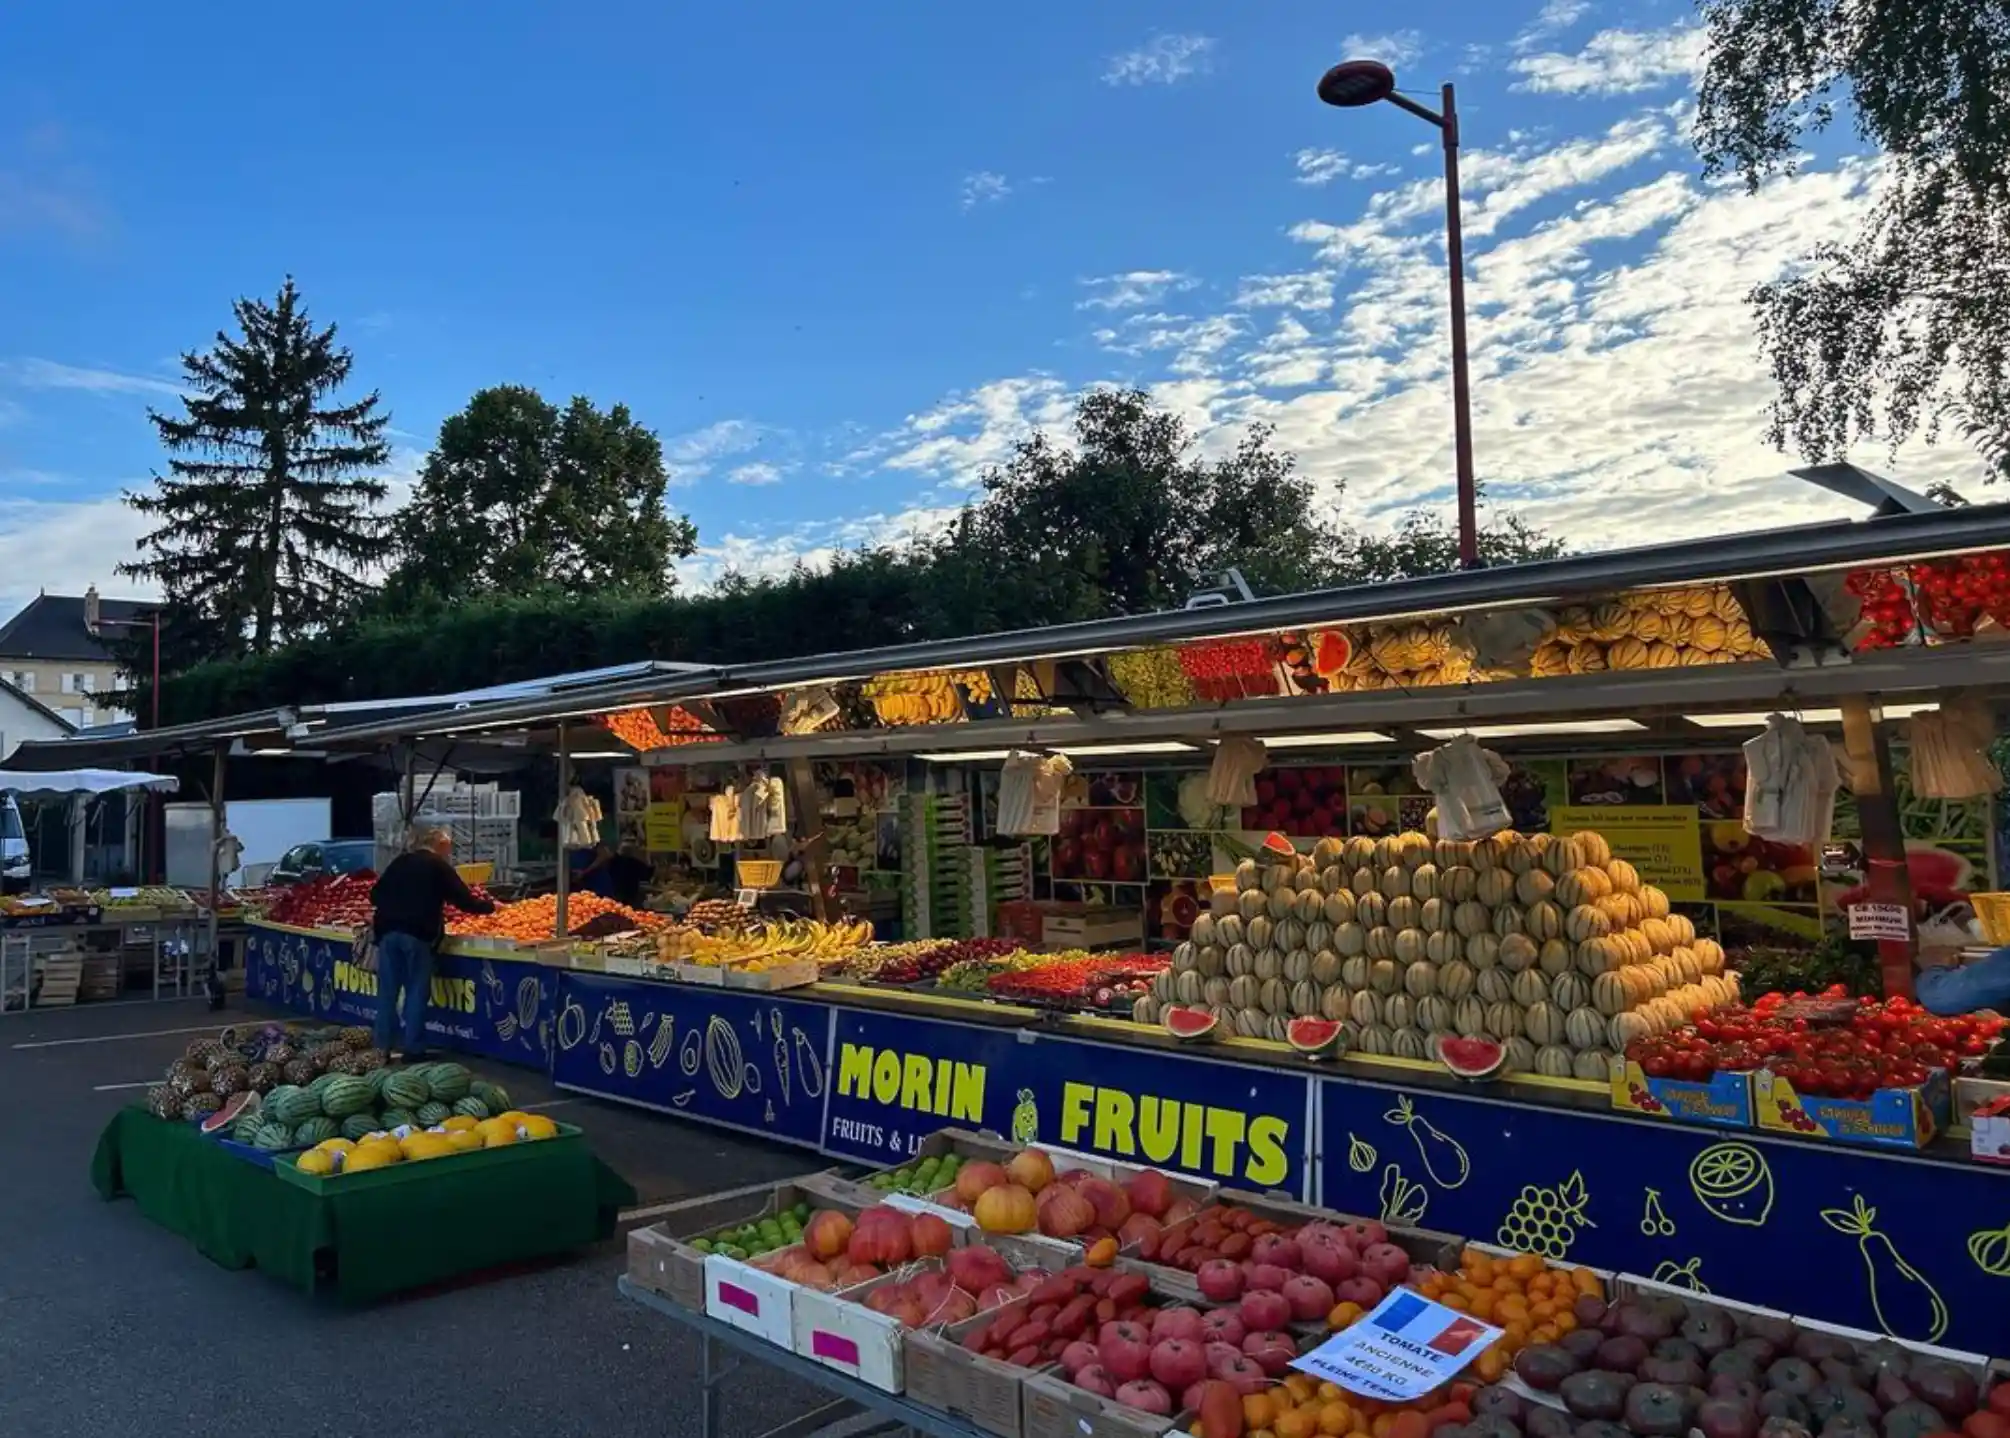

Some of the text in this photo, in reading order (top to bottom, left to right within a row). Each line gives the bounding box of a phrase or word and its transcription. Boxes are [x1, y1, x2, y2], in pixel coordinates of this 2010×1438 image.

[334, 960, 476, 1013] MORI UITS
[837, 1043, 1289, 1186] MORIN FRUITS
[832, 1117, 883, 1148] FRUITS
[889, 1130, 902, 1152] &
[1354, 1340, 1436, 1378] ANCIENNE
[1380, 1332, 1445, 1363] TOMATE
[1311, 1358, 1361, 1381] PLEINE
